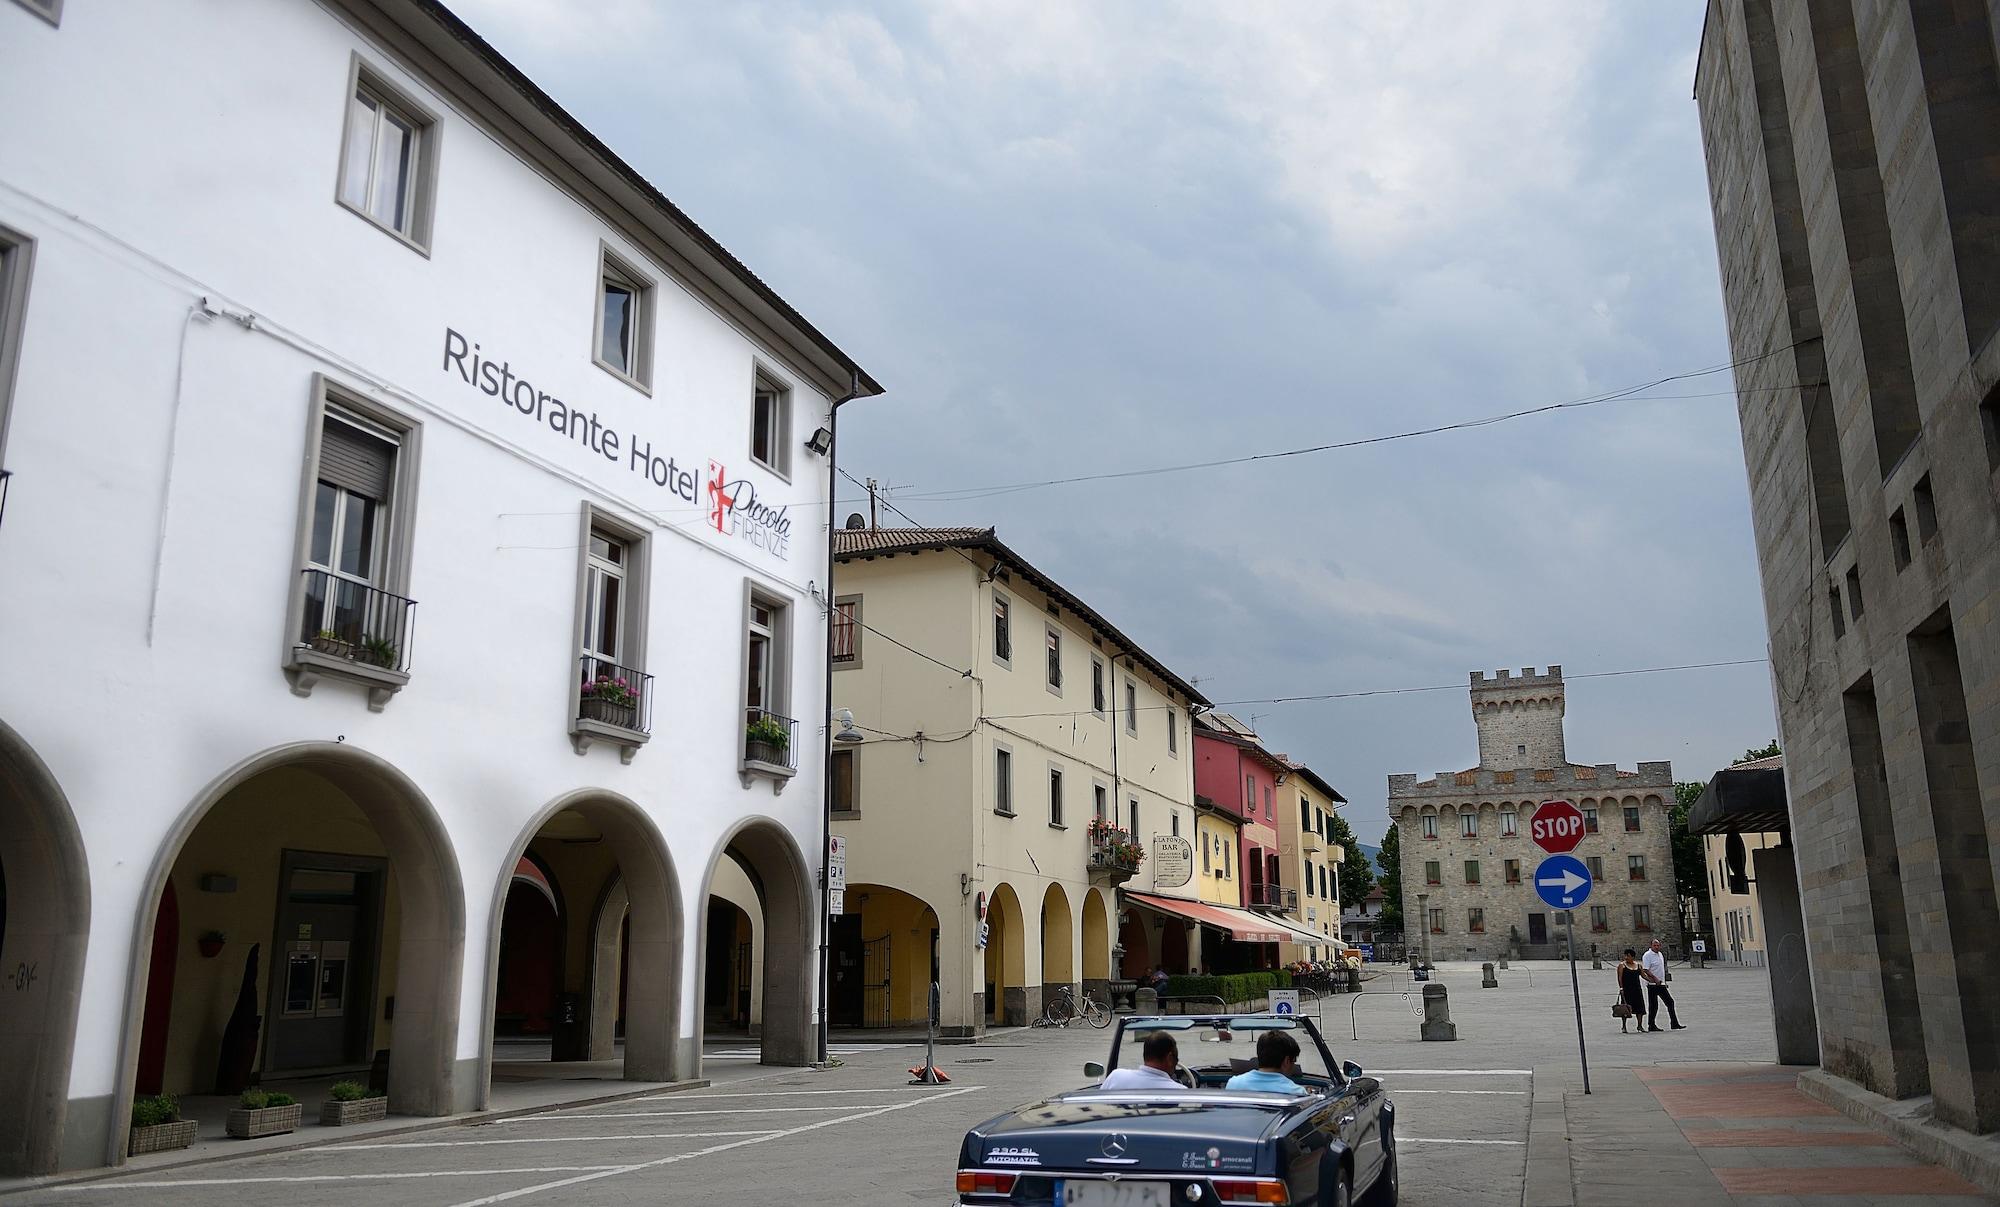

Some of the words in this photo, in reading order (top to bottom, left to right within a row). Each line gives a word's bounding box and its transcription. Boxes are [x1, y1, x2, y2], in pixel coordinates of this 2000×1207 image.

[443, 327, 619, 461] Ristorante
[630, 434, 699, 504] Hotel
[716, 480, 791, 537] Piccola
[733, 511, 789, 561] FIRENZE
[1533, 815, 1581, 840] STOP
